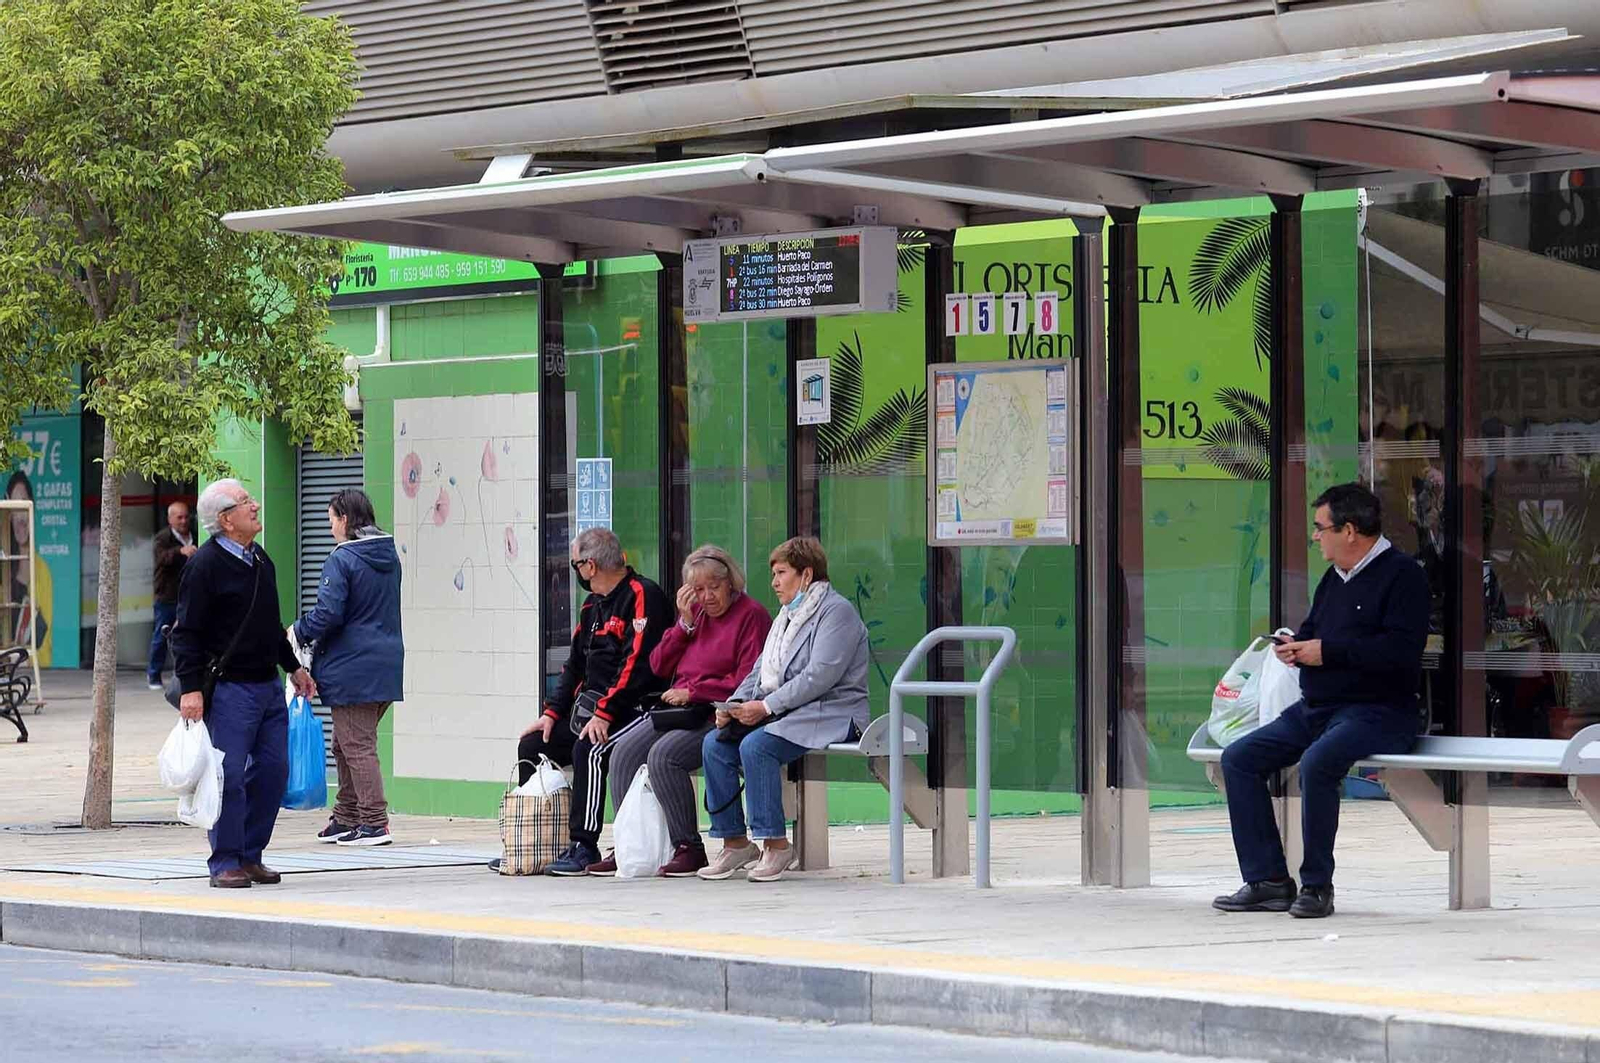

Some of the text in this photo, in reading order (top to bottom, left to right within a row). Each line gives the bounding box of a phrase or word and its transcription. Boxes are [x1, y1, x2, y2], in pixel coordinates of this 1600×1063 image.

[748, 242, 769, 253] TIEMPO
[1544, 244, 1598, 260] SCHMDT
[743, 254, 750, 264] 11
[751, 254, 774, 264] minutos
[777, 251, 796, 261] Huerto
[798, 249, 811, 260] Paco
[403, 267, 417, 282] 659
[456, 262, 471, 277] 959
[473, 260, 488, 275] 151
[746, 265, 757, 275] bus
[758, 264, 766, 274] 16
[766, 264, 777, 274] min
[777, 261, 801, 273] Barriada
[801, 261, 810, 271] del
[811, 260, 833, 271] Carmen
[743, 277, 750, 287] 22
[751, 277, 774, 287] minutos
[777, 273, 806, 285] Hospitales
[746, 288, 757, 298] bus
[758, 287, 766, 297] 22
[766, 286, 777, 296] min
[777, 286, 794, 298] Diego
[746, 299, 757, 310] bus
[758, 298, 766, 309] 30
[766, 298, 777, 308] min
[777, 297, 797, 308] Huerto
[797, 296, 811, 306] Paco
[952, 302, 960, 333] 1
[978, 301, 989, 332] 5
[1011, 302, 1020, 332] 7
[1041, 300, 1053, 331] 8
[1008, 323, 1073, 360] Man
[1143, 400, 1202, 439] 513
[43, 482, 72, 497] GAFAS
